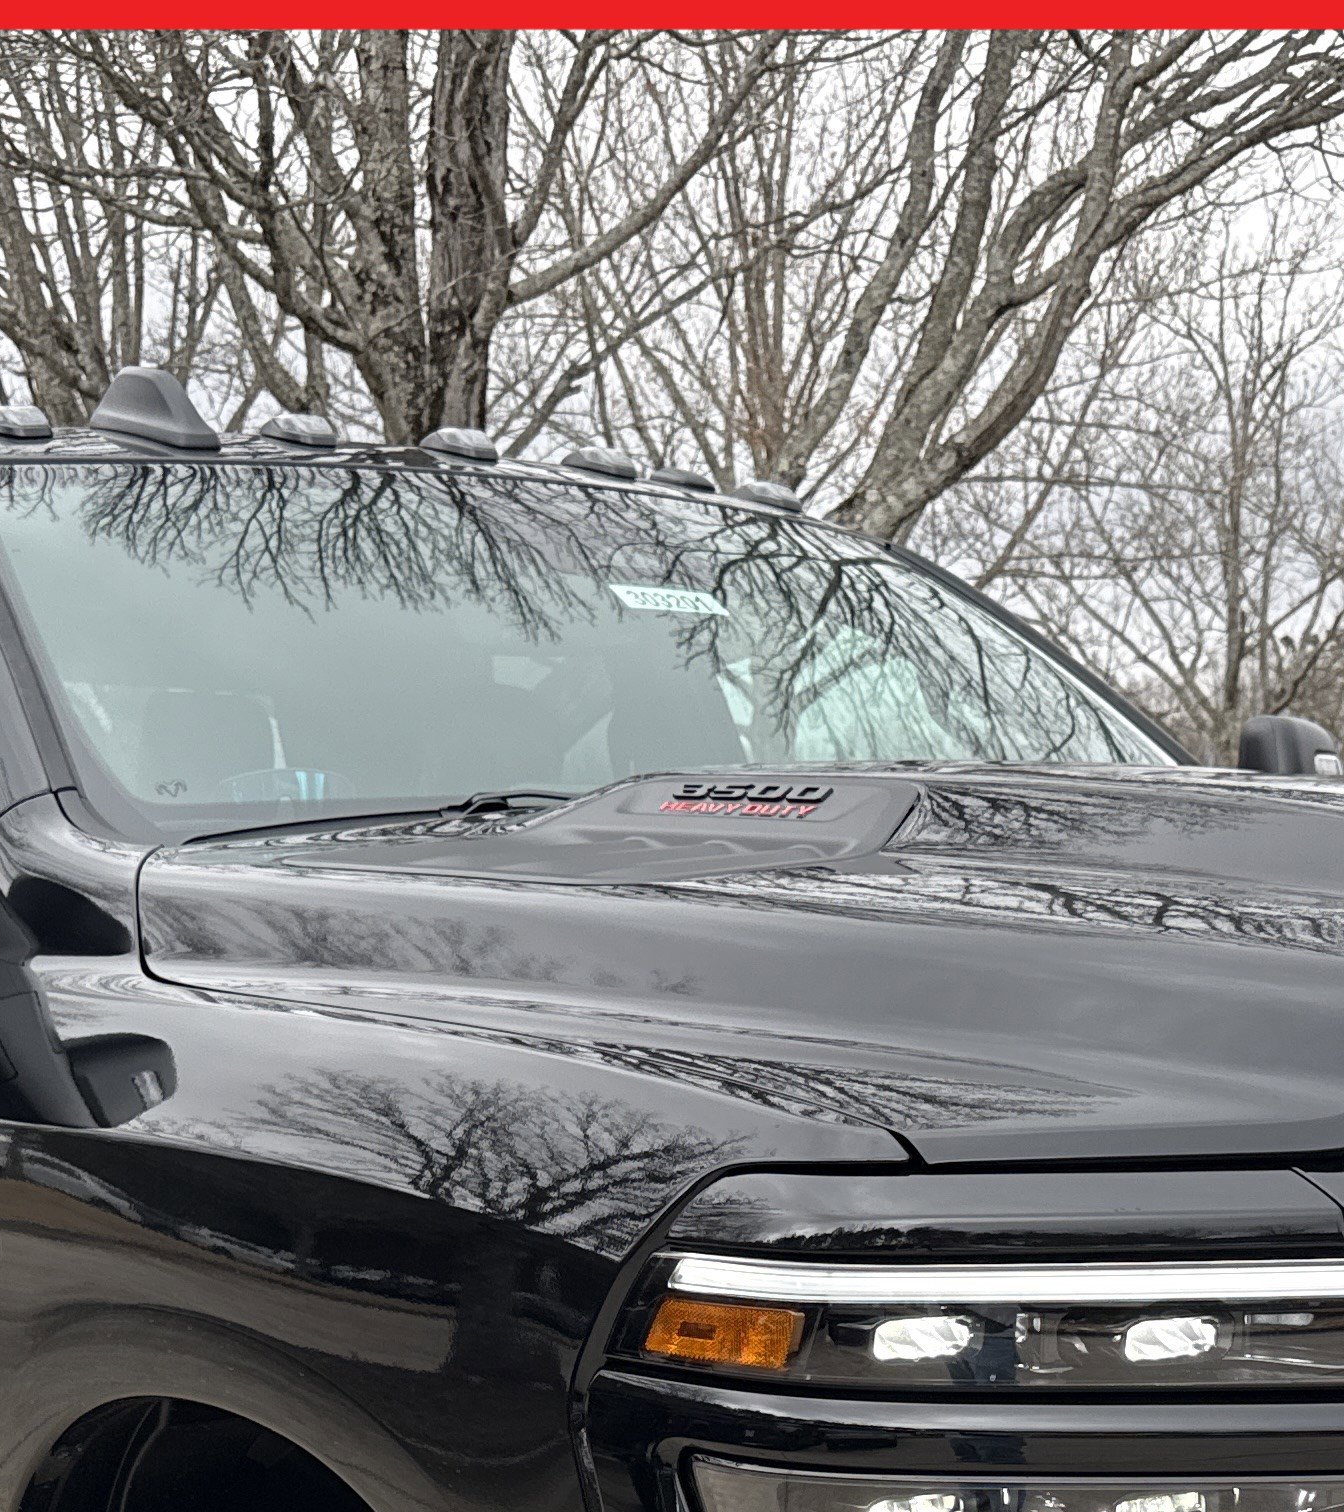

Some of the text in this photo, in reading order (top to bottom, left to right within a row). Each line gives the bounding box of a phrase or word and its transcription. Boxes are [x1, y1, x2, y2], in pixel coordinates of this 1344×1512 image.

[672, 783, 834, 802] 3500
[658, 801, 819, 819] HEAVY DUTY
